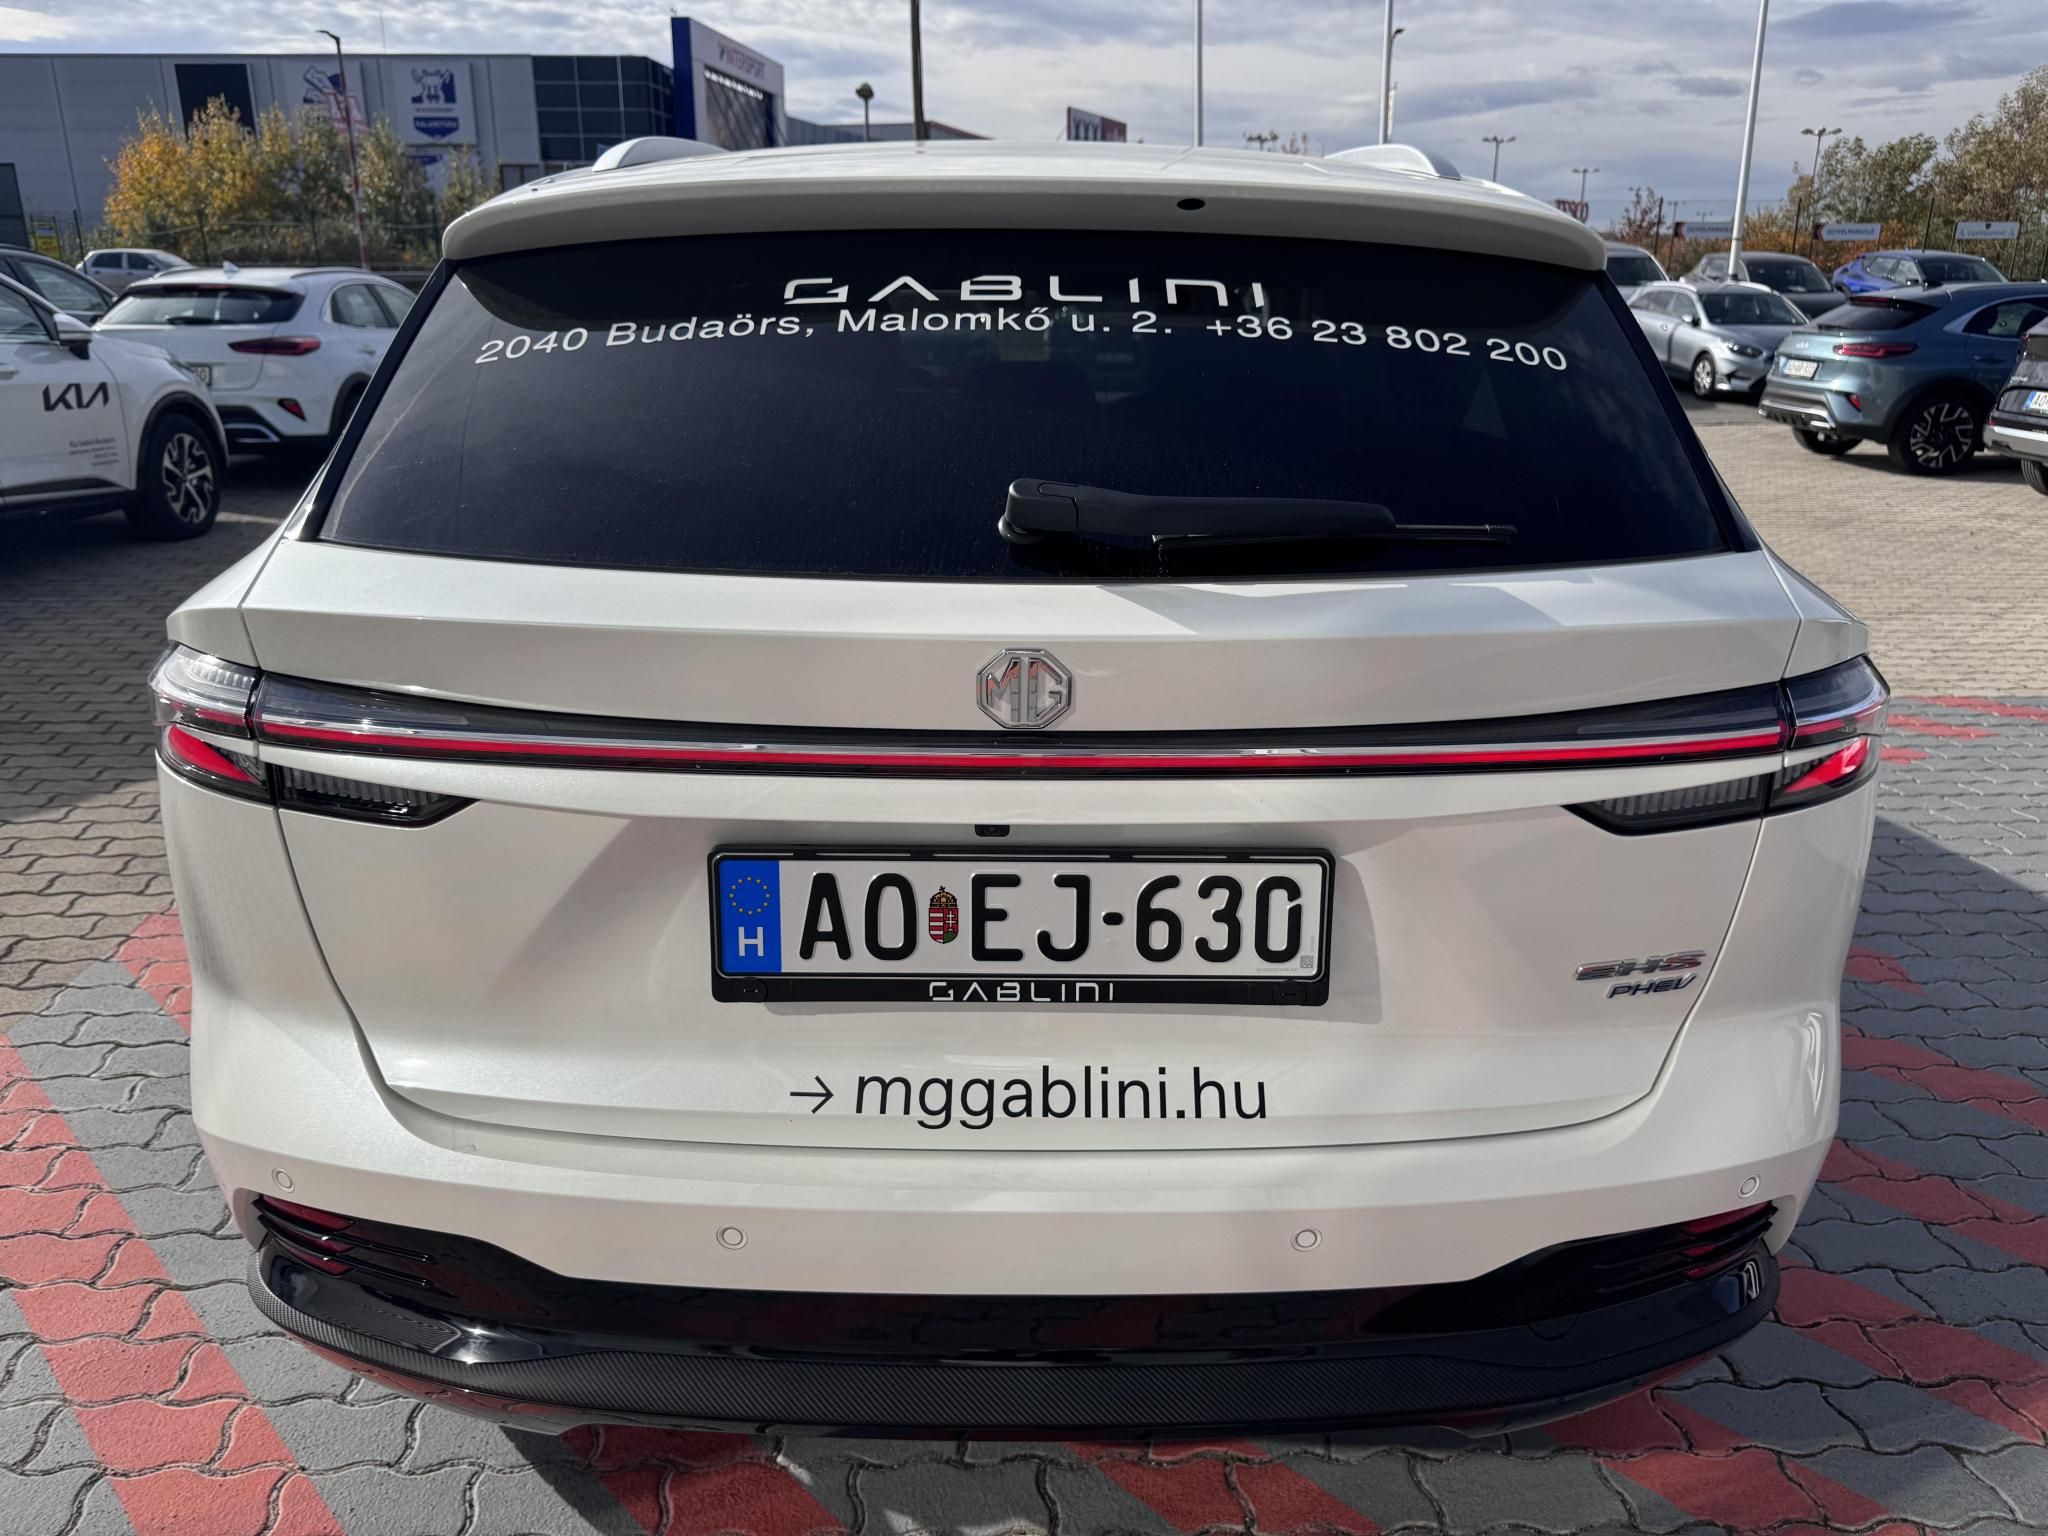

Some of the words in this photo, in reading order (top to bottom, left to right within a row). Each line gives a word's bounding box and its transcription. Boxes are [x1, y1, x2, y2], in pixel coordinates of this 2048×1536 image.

[784, 275, 1265, 308] GABLINI
[474, 328, 588, 364] 2040
[606, 313, 815, 347] Budaörs,
[837, 306, 1051, 333] Malomkő
[1071, 313, 1110, 333] u.
[1131, 310, 1172, 334] 2.
[1206, 315, 1293, 340] +36
[1311, 320, 1367, 346] 23
[1385, 326, 1471, 356] 802
[1486, 338, 1568, 371] 200
[42, 381, 110, 412] KIA
[982, 654, 1066, 724] MG
[799, 872, 918, 961] AO
[971, 873, 1302, 964] EJ-630
[738, 926, 764, 957] H
[1576, 949, 1706, 981] EHS
[929, 981, 1114, 1002] GABLINI
[1606, 972, 1698, 999] PHEV
[855, 1065, 1267, 1129] mggablini.hu
